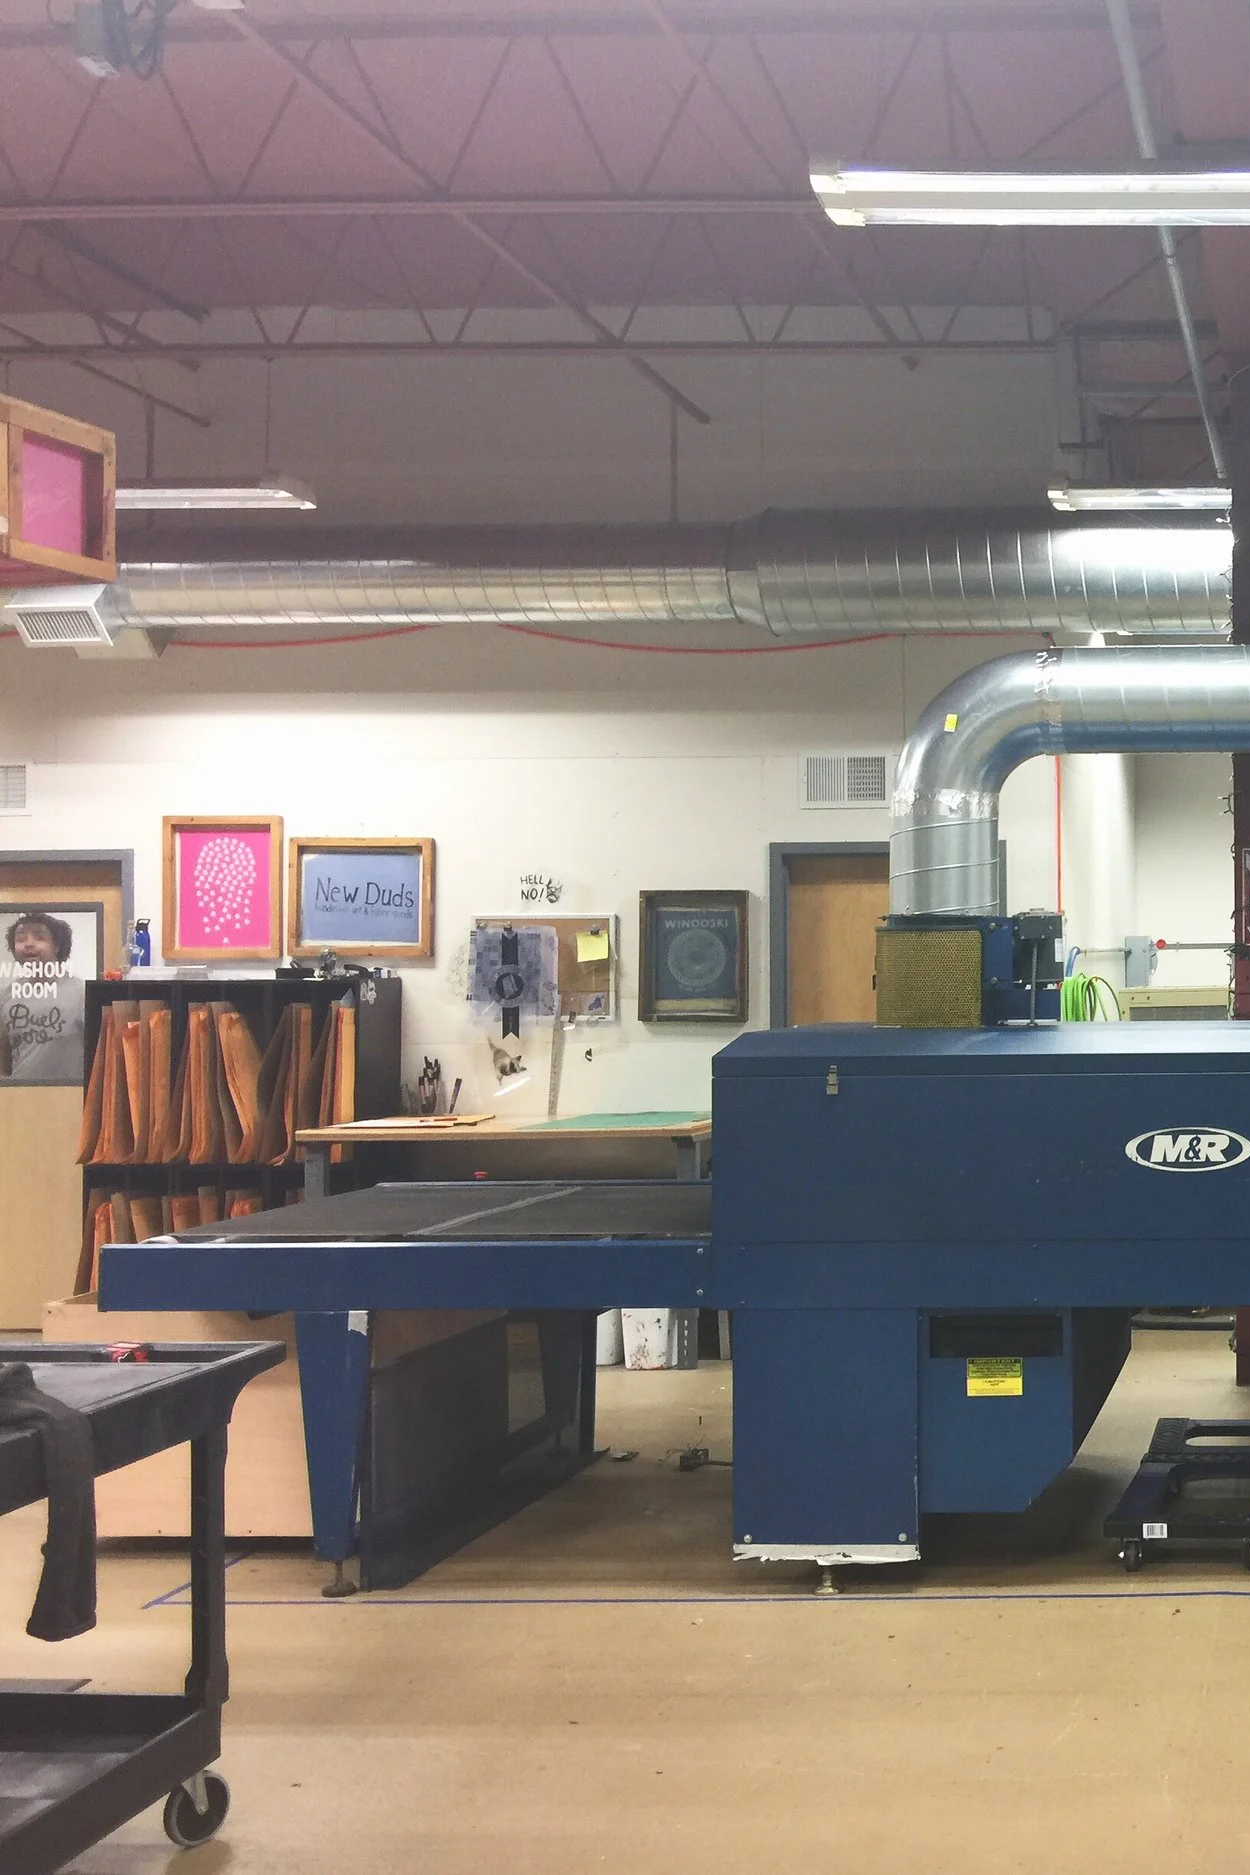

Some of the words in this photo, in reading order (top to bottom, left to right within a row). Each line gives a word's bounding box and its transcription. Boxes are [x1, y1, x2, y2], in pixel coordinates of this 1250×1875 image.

[520, 875, 544, 885] HELL
[315, 877, 359, 904] New
[365, 882, 414, 908] Duds
[521, 888, 544, 902] NO!
[11, 981, 57, 999] ROOM
[1150, 1134, 1230, 1162] M&R
